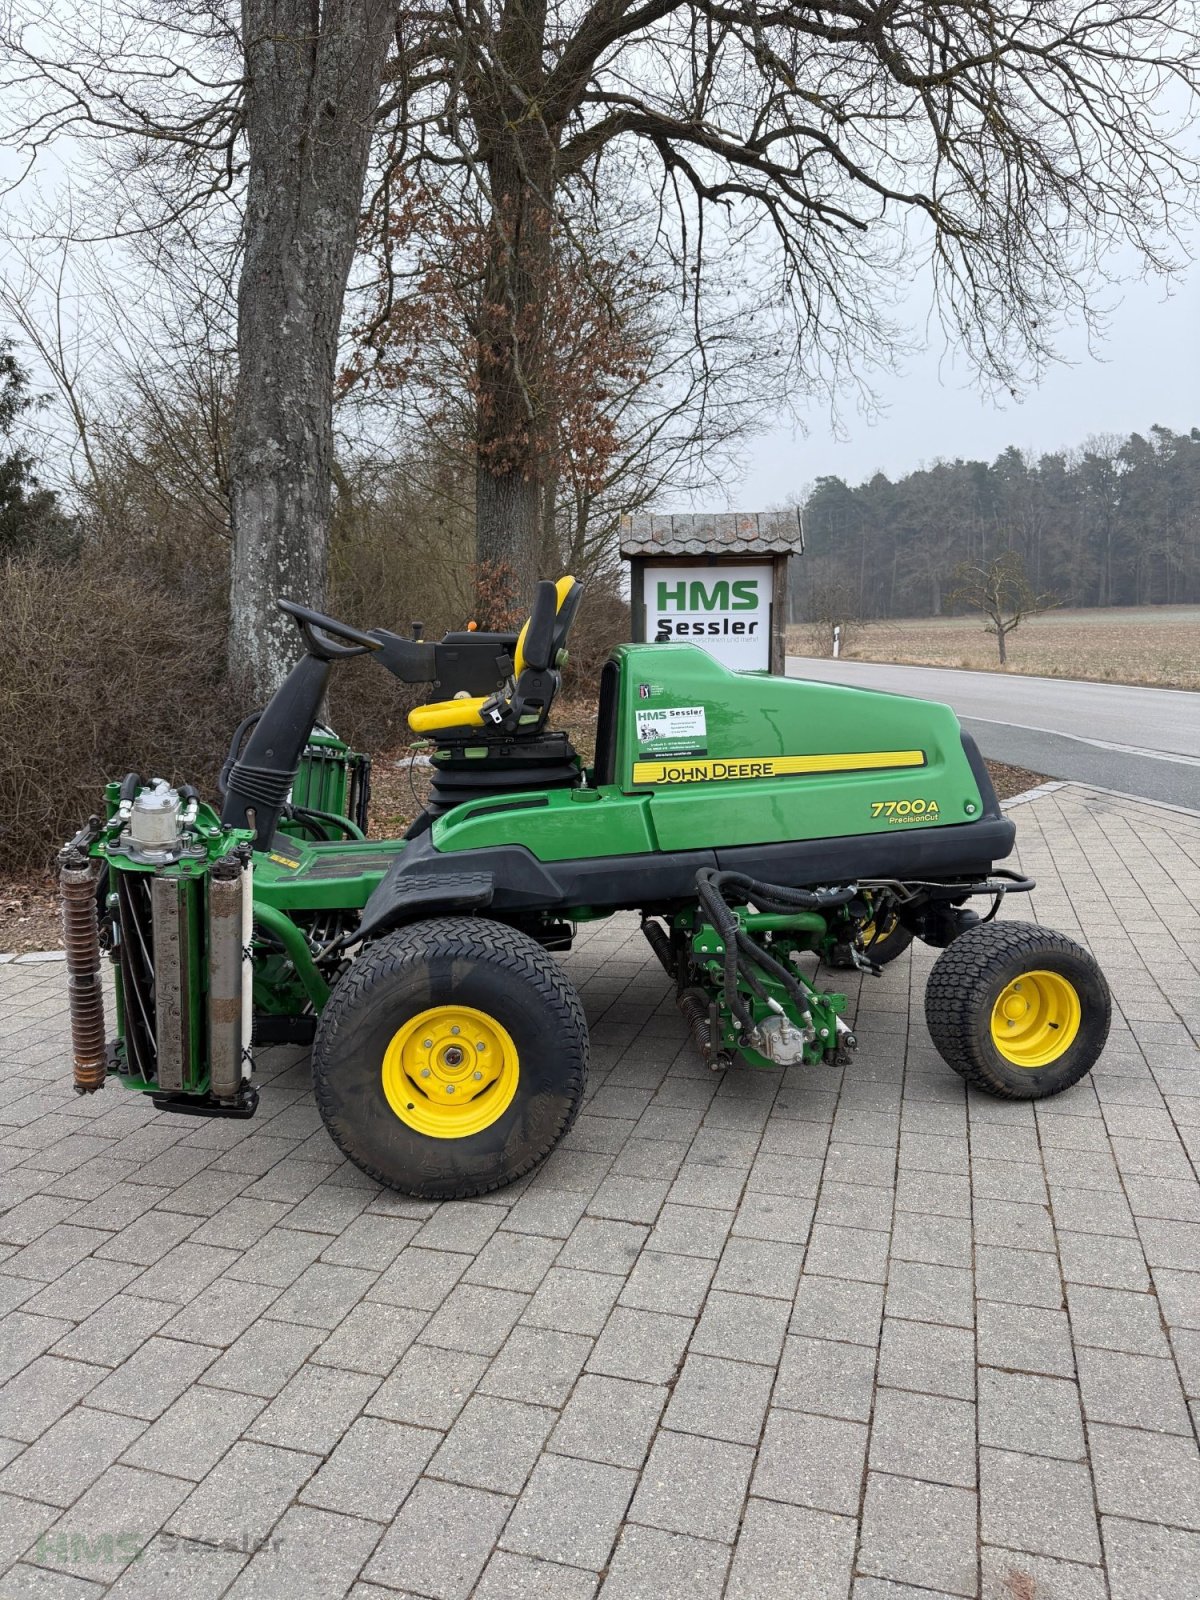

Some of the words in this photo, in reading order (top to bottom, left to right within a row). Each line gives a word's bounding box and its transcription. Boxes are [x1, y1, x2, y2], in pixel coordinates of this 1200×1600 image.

[657, 580, 759, 611] HMS
[657, 618, 759, 636] Sessler
[637, 711, 667, 721] HMS
[669, 709, 702, 717] Sessler
[656, 766, 708, 782] JOHN
[712, 763, 774, 778] DEERE
[871, 799, 939, 818] 7700A
[888, 813, 939, 824] PrecisionCut
